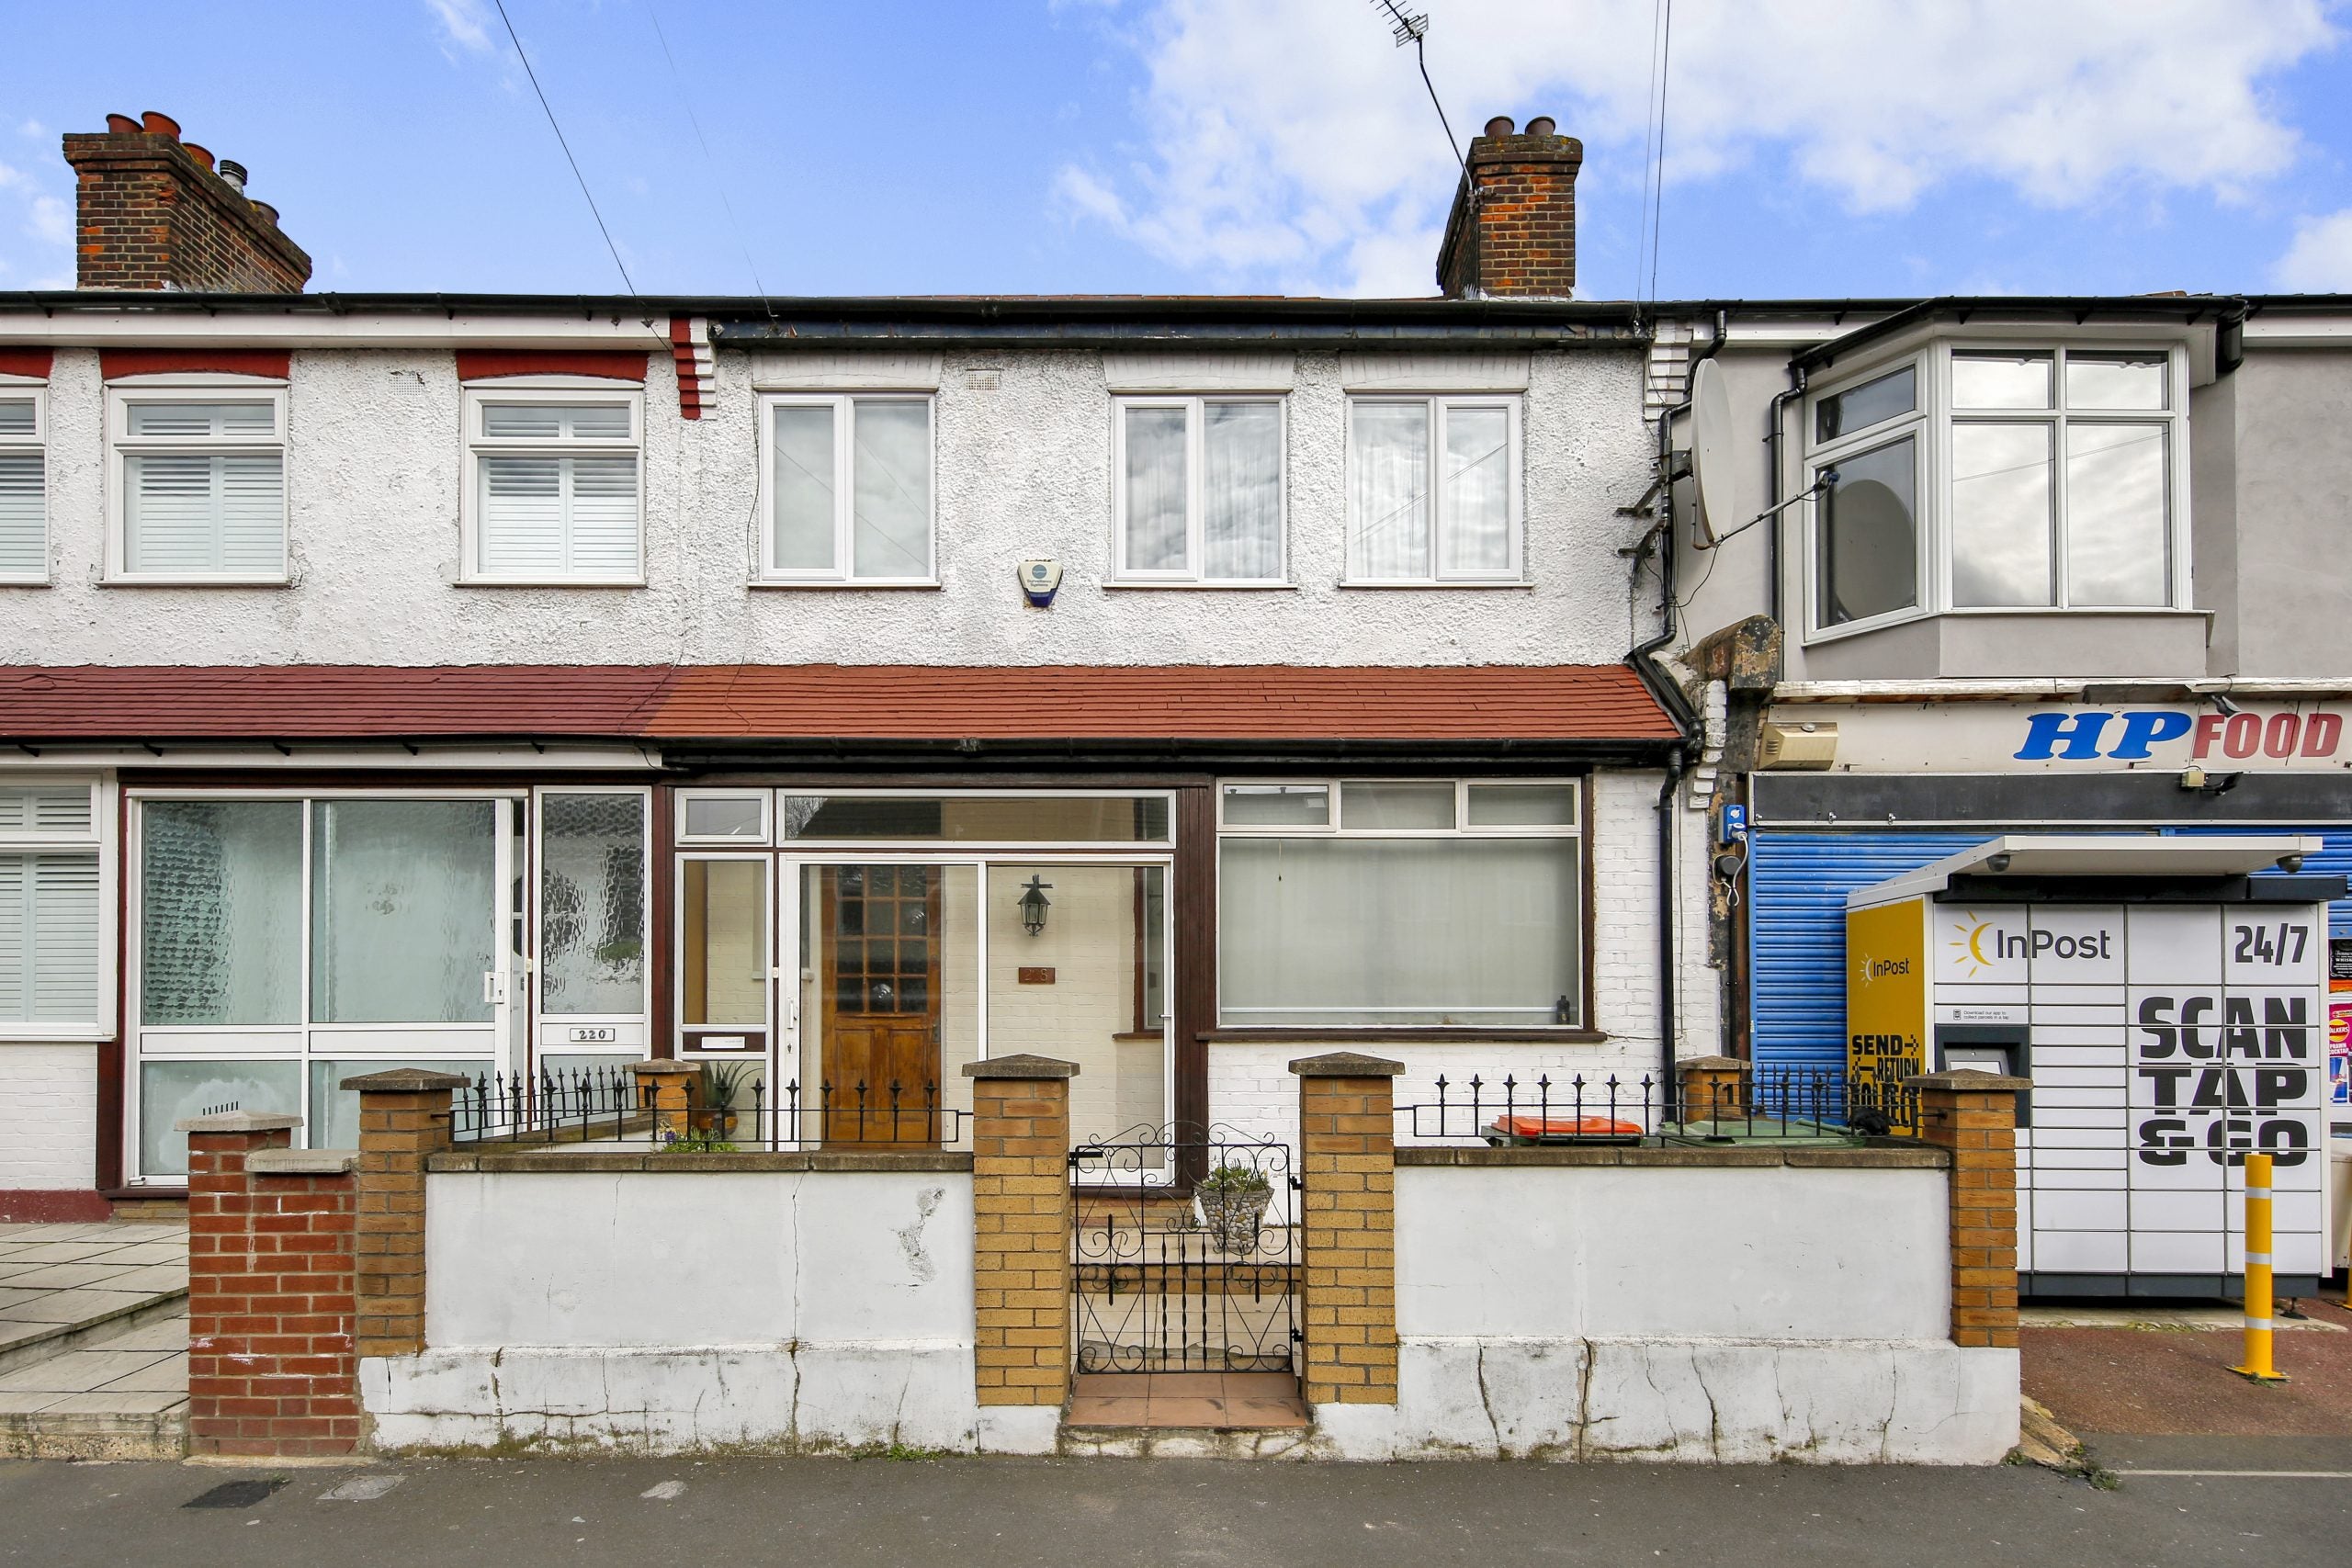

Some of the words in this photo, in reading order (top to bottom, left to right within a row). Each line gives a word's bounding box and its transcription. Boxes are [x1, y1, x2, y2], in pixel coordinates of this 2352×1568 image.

[2013, 712, 2192, 760] HP
[2192, 713, 2343, 760] FOOD
[1996, 929, 2110, 960] InPost
[2234, 922, 2309, 966] 24/7
[1873, 957, 1910, 977] InPost
[579, 1030, 606, 1039] 220
[1852, 1034, 1903, 1055] SEND
[2139, 997, 2307, 1059] SCAN
[1877, 1056, 1919, 1082] RETURN
[2139, 1062, 2308, 1116] TAP
[1850, 1082, 1919, 1127] OECT
[2139, 1119, 2194, 1166] &
[2207, 1119, 2308, 1167] GO
